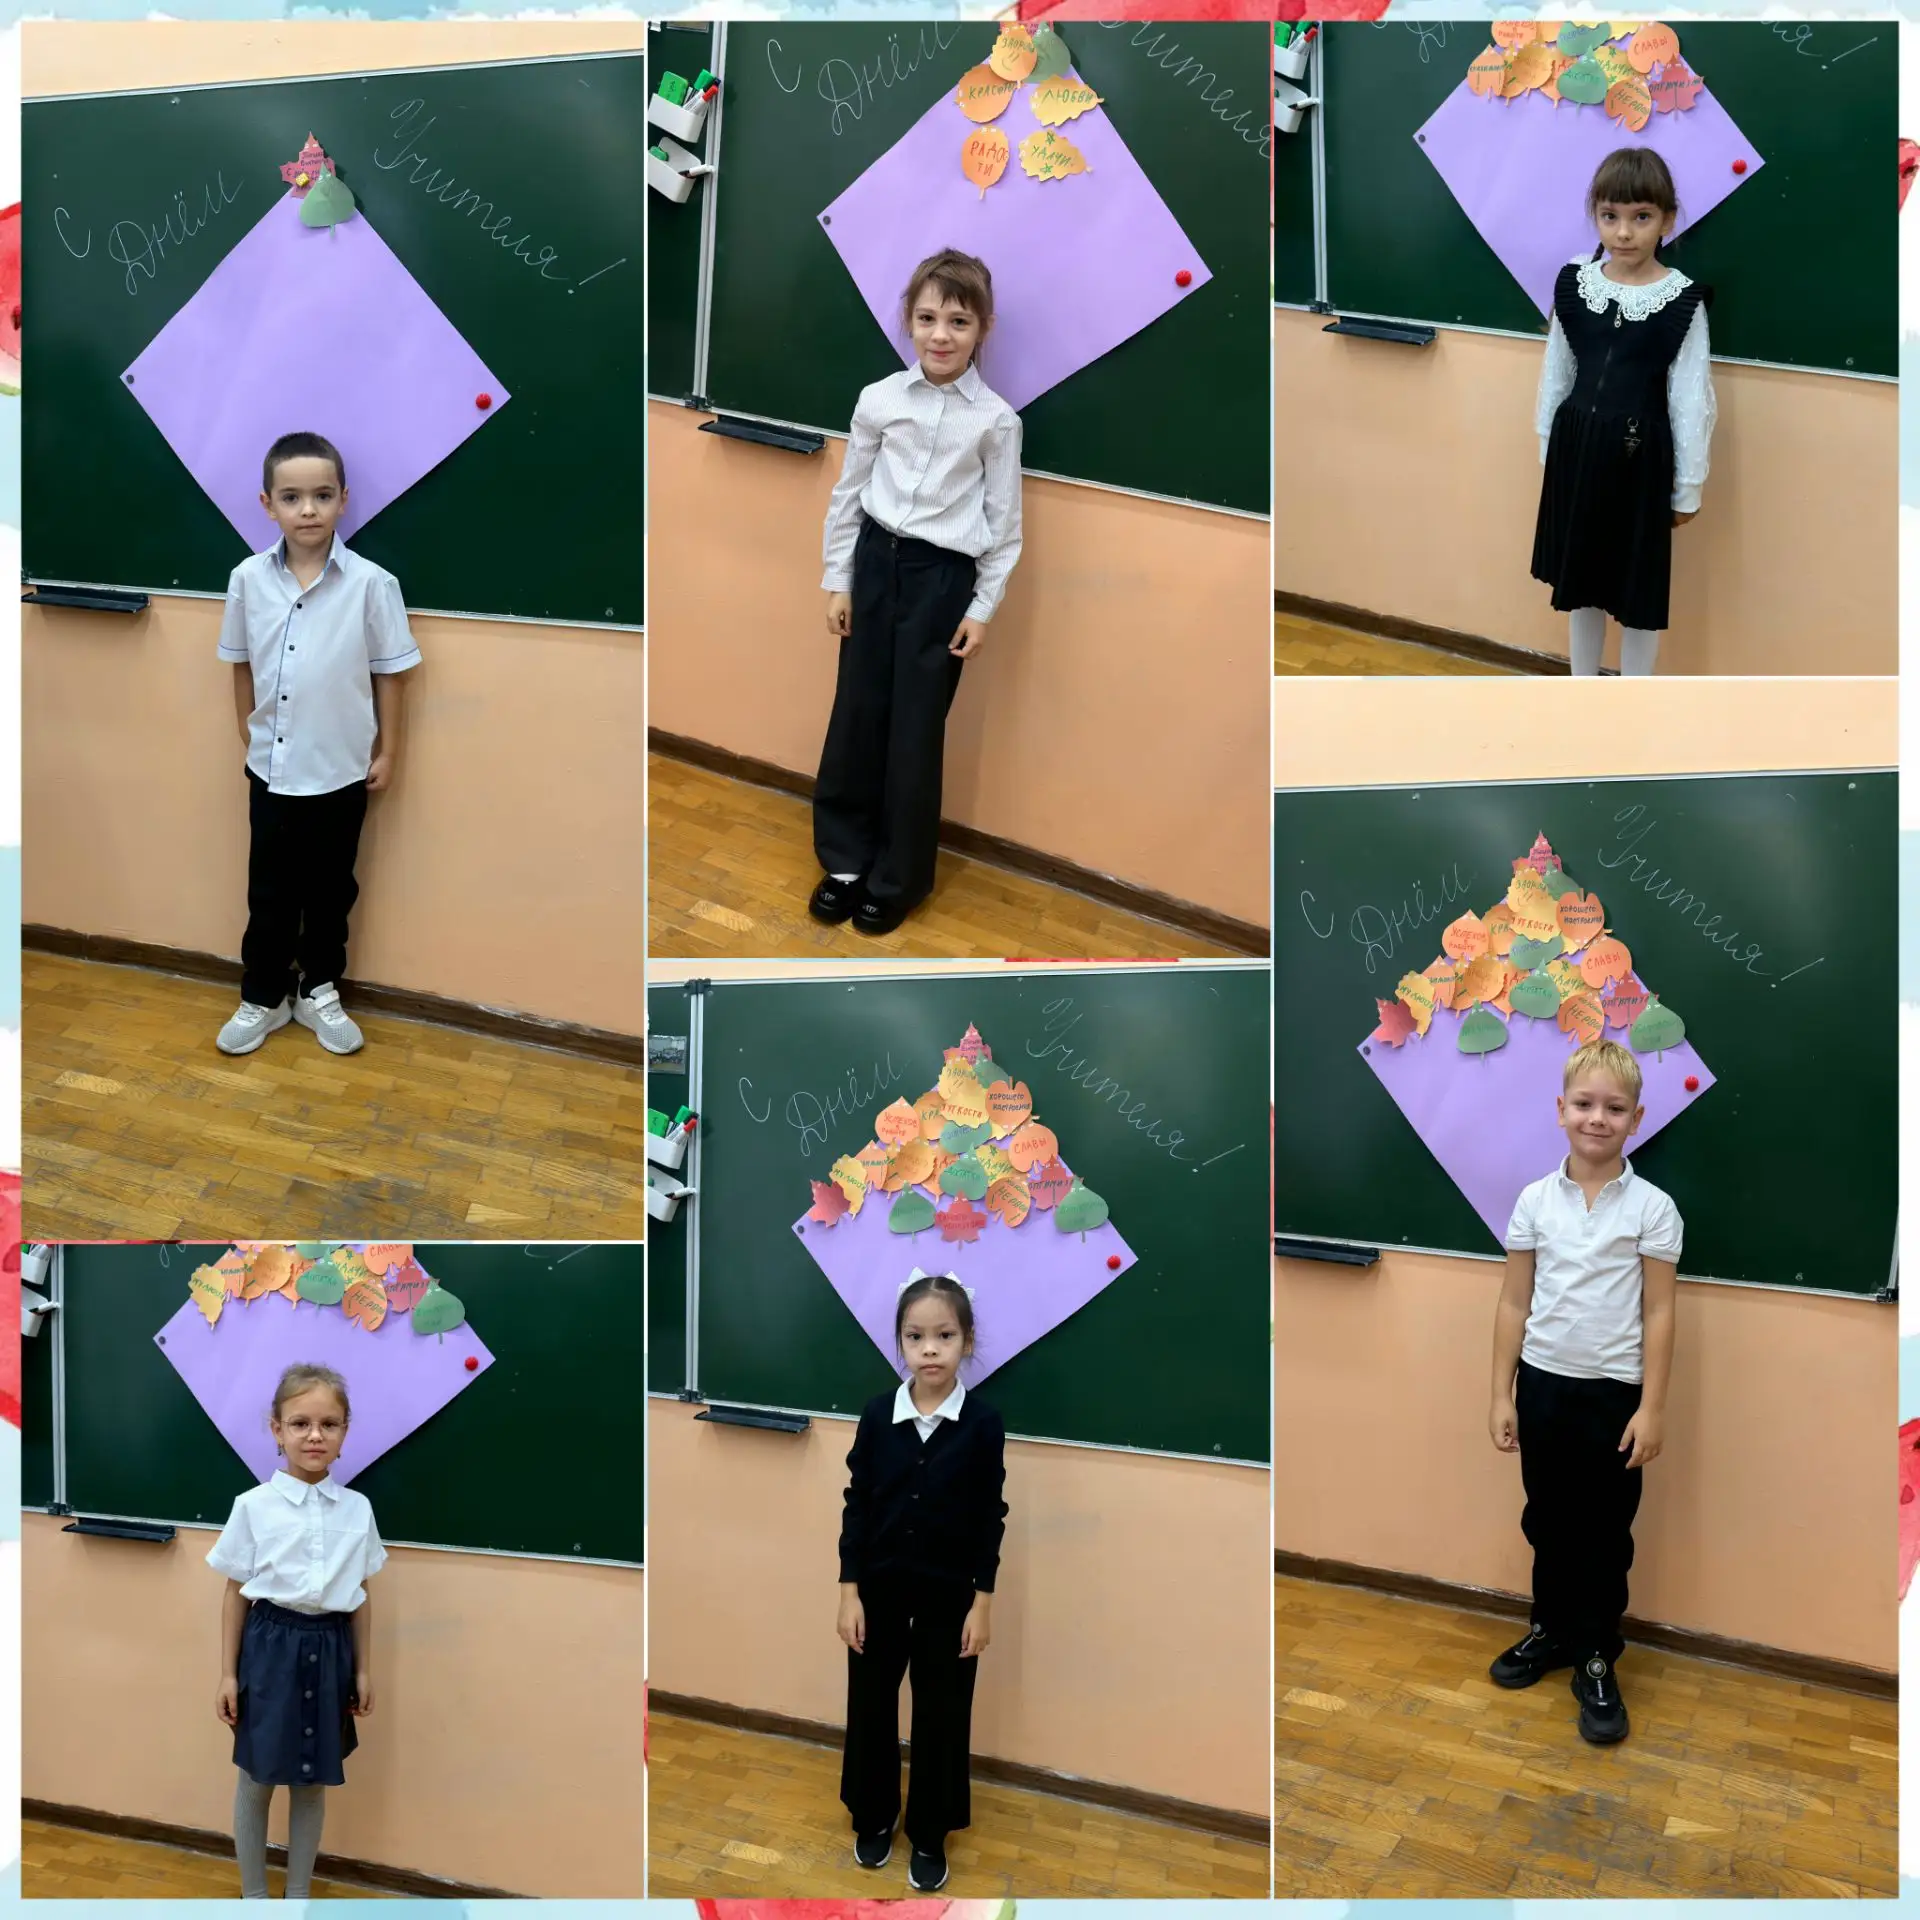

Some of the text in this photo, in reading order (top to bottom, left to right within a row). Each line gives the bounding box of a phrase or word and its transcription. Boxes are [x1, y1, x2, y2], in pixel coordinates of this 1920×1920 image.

[1633, 36, 1668, 55] СЛАВЫ
[767, 38, 802, 93] С
[1098, 21, 1271, 159] чителя
[1041, 88, 1094, 105] ЛЮБВИ
[54, 207, 91, 258] С
[108, 170, 243, 295] Днём
[1299, 890, 1334, 939] С
[1351, 863, 1474, 974] Днём
[1586, 952, 1621, 970] СЛАВЫ
[738, 1076, 772, 1123] С
[786, 1052, 902, 1157] Днём
[1014, 1137, 1048, 1154] СЛАВЫ
